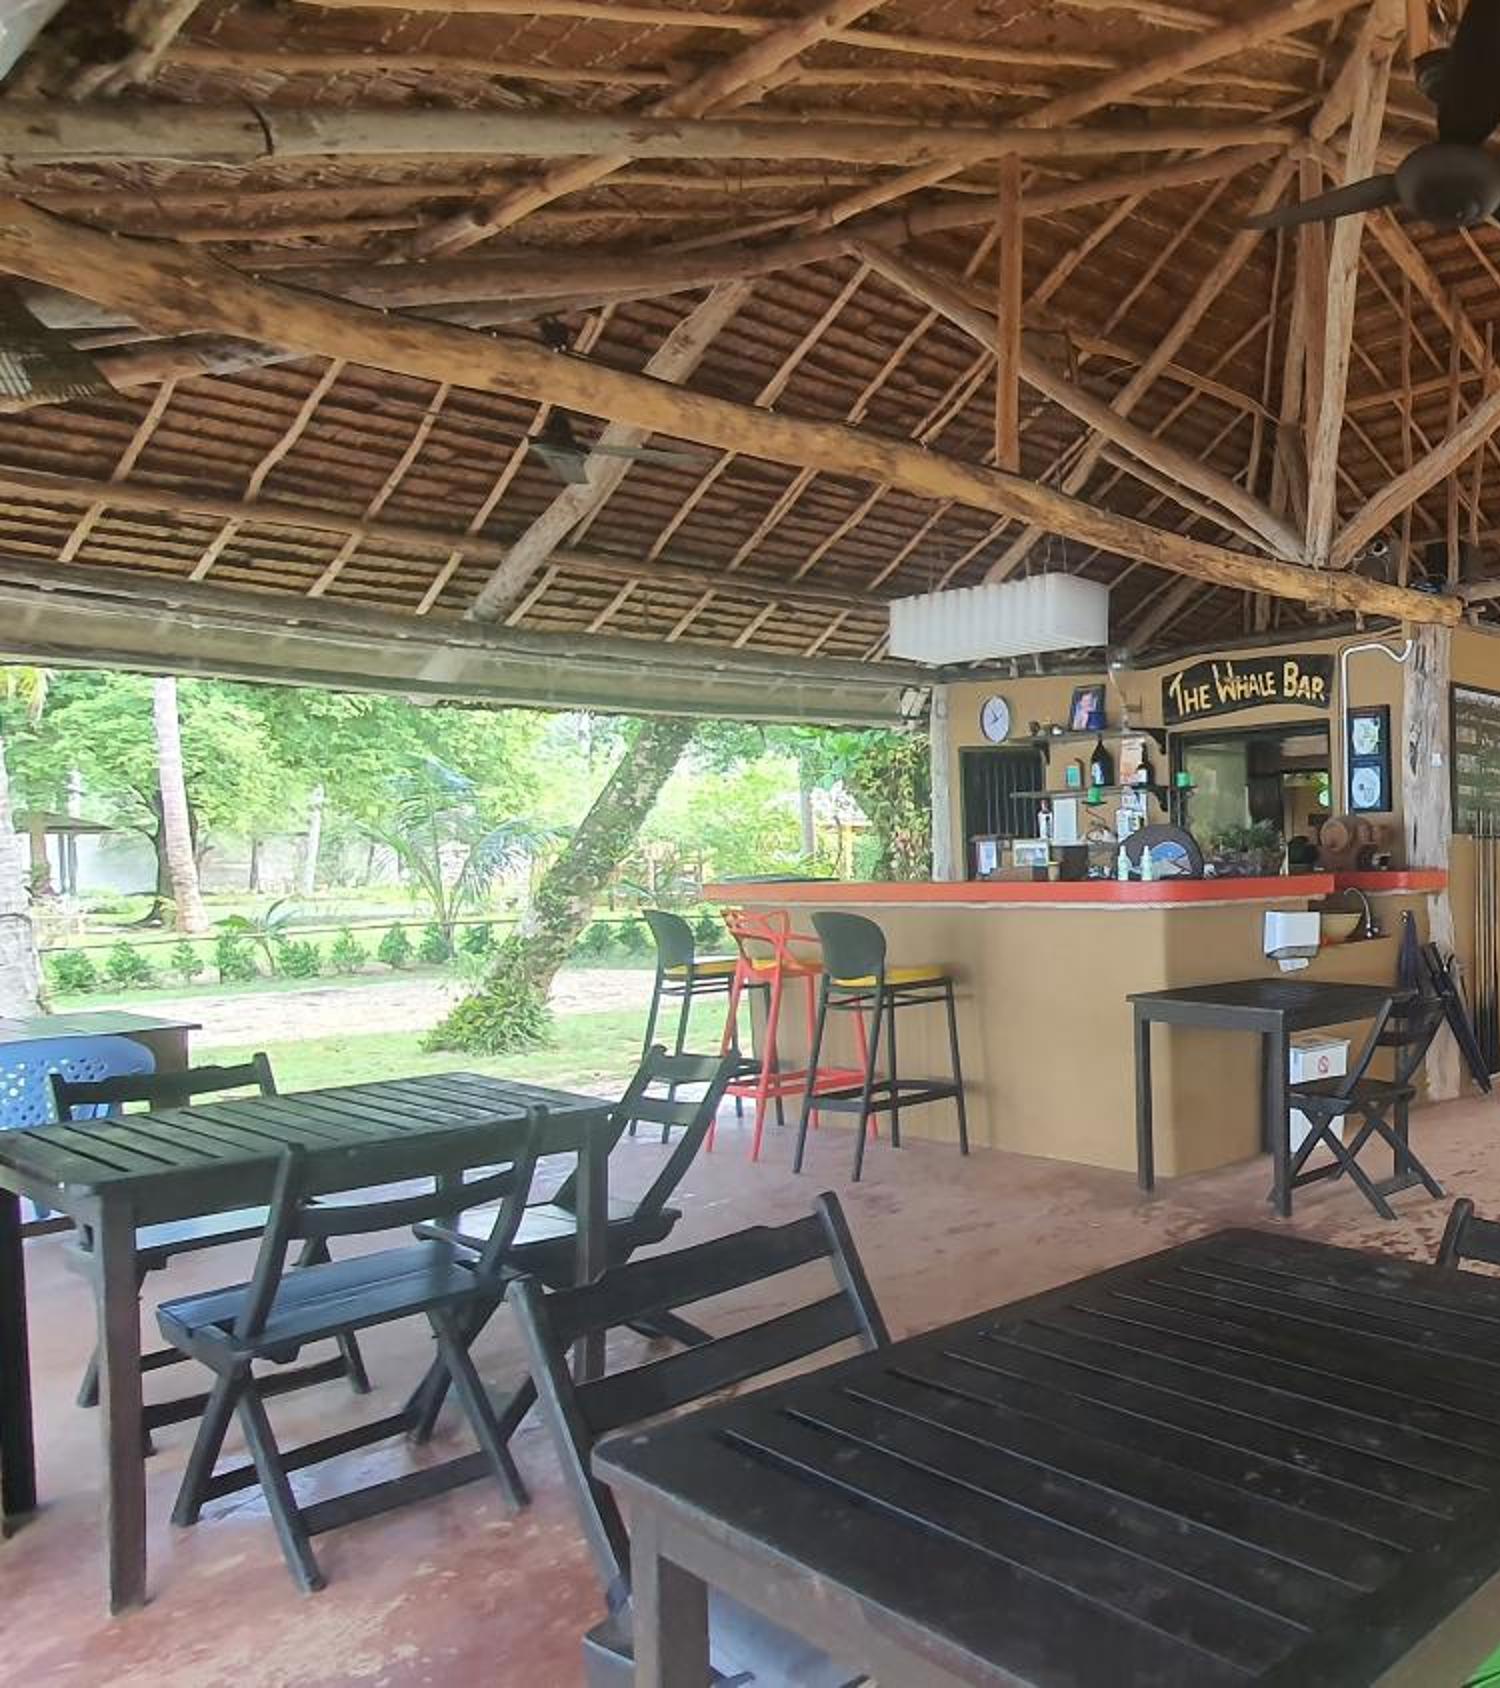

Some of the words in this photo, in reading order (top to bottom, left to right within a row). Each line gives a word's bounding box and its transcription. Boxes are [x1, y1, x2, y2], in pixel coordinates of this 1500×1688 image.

[1169, 672, 1212, 716] THE
[1212, 661, 1277, 704] WHALE
[1283, 661, 1325, 702] BAR
